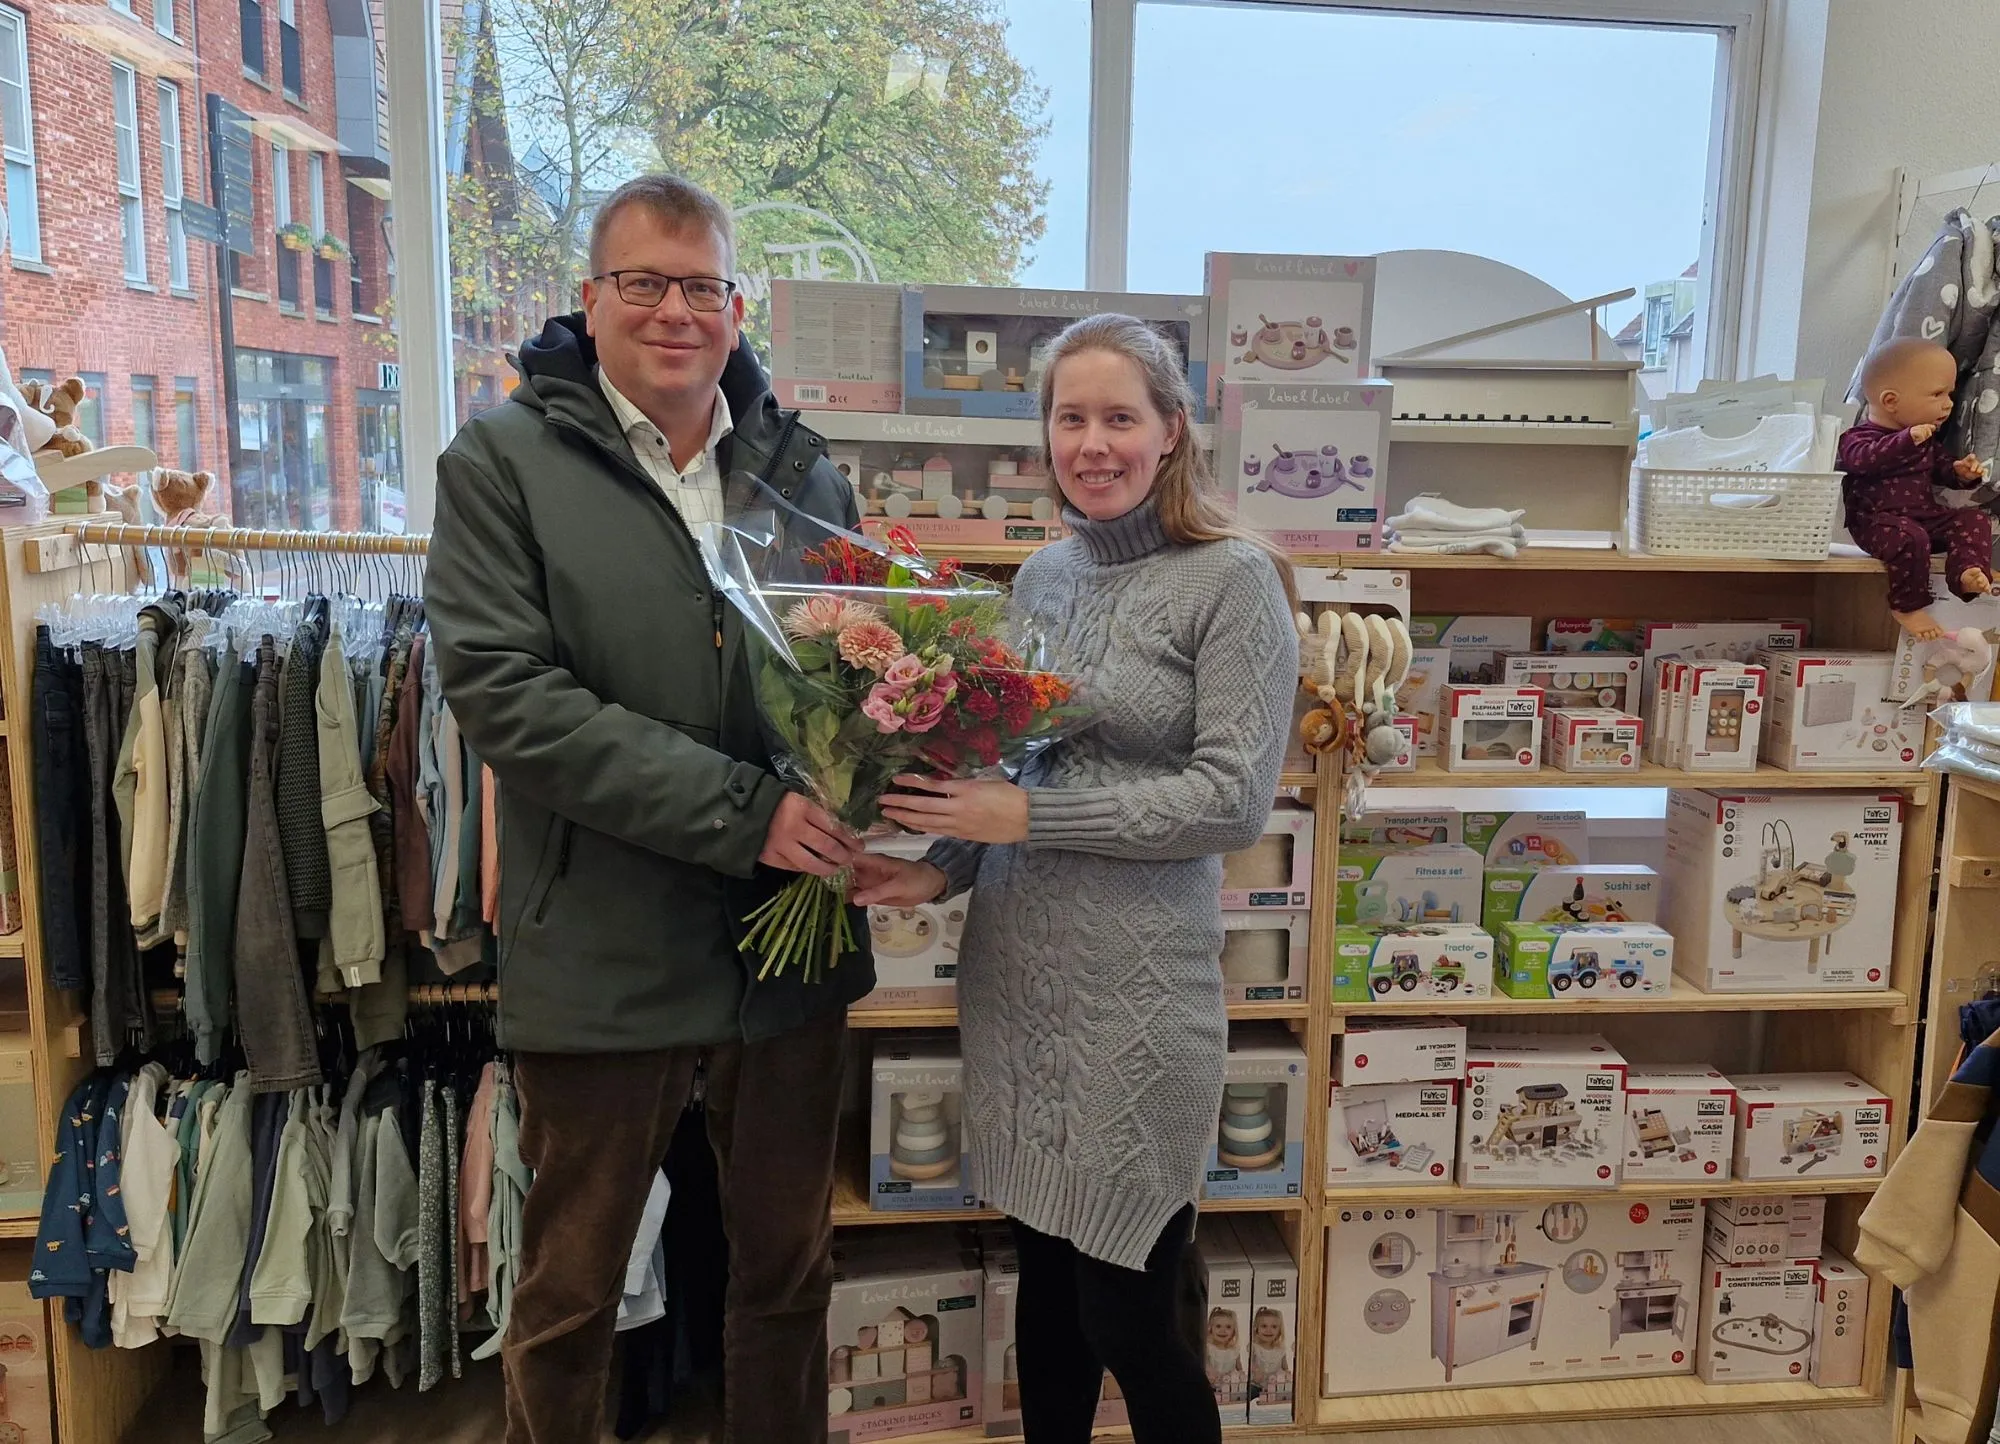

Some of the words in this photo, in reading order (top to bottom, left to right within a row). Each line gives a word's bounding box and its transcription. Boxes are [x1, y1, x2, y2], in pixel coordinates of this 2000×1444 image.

[1268, 386, 1307, 403] label
[1312, 389, 1350, 404] label
[881, 418, 920, 436] label
[925, 420, 964, 437] label
[1284, 534, 1319, 542] TEASET
[1453, 635, 1469, 643] Tool
[1384, 817, 1421, 825] Transport
[1423, 816, 1448, 824] Puzzle
[1415, 867, 1446, 875] Fitness
[1448, 867, 1463, 875] set
[1604, 881, 1632, 891] Sushi
[1635, 881, 1652, 891] set
[1444, 943, 1475, 952] Tractor
[1623, 941, 1654, 949] Tractor
[883, 990, 918, 999] TEASET
[1395, 1111, 1429, 1119] MEDICAL
[1662, 1217, 1693, 1225] KITCHEN
[861, 1415, 906, 1430] STACKING
[908, 1410, 943, 1423] BLOCKS
